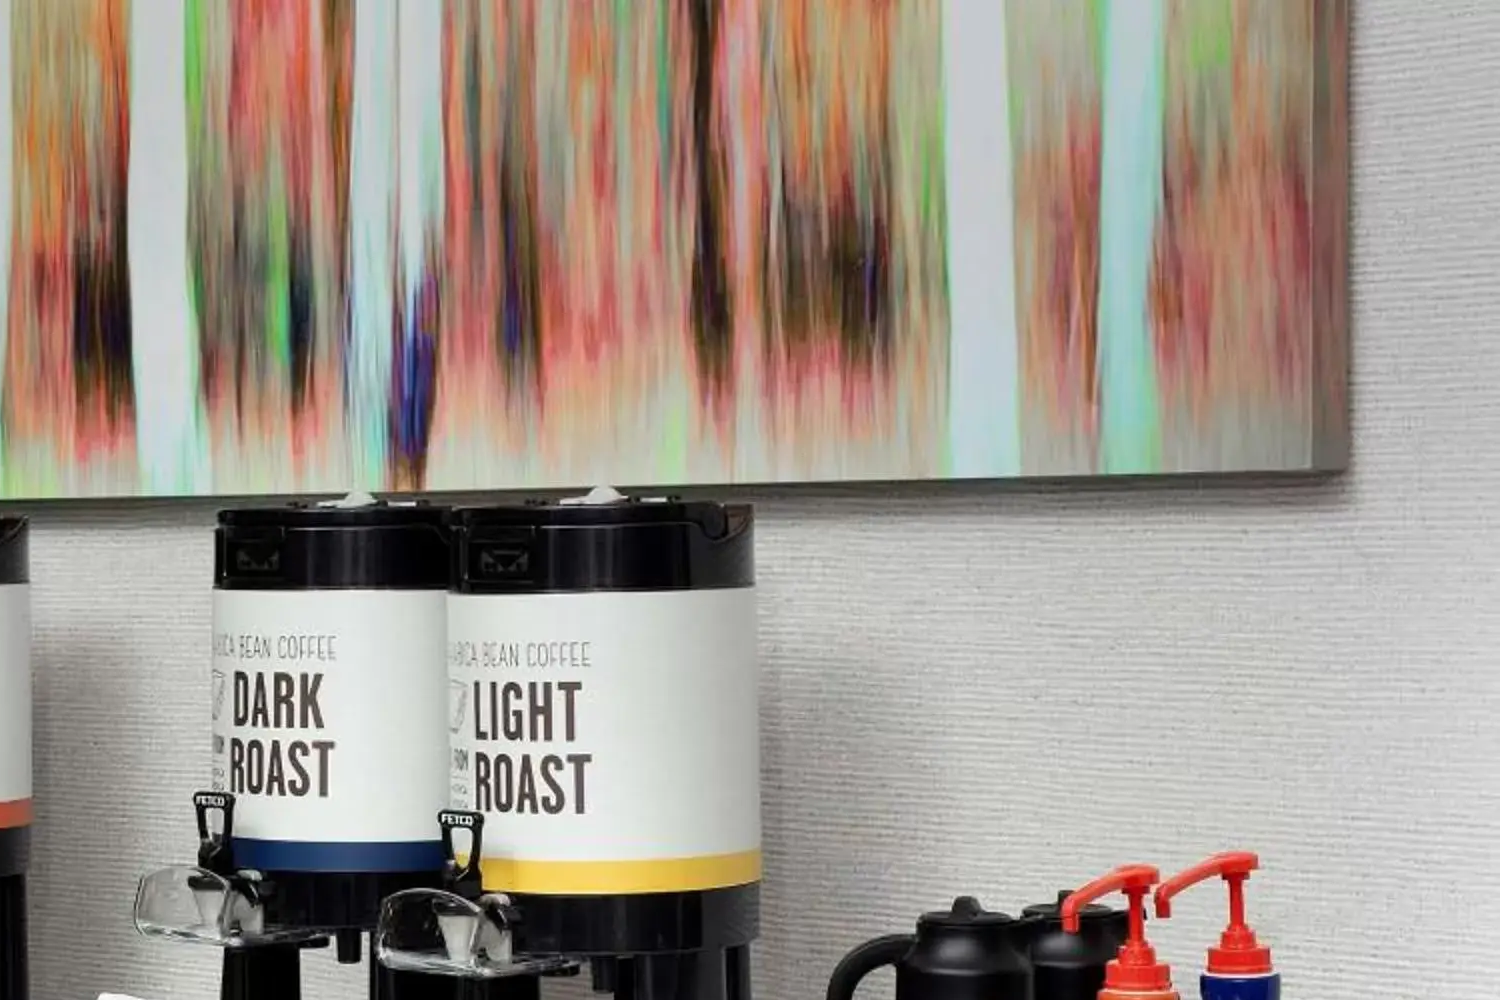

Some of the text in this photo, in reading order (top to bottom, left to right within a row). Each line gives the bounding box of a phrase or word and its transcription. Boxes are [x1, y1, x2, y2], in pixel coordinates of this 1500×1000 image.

[239, 635, 271, 660] BEAN
[277, 634, 338, 661] COFFEE
[482, 641, 519, 667] BEAN
[526, 641, 592, 667] COFFEE
[233, 670, 325, 729] DARK
[473, 680, 583, 742] LIGHT
[230, 737, 336, 798] ROAST
[474, 751, 593, 815] ROAST
[441, 813, 473, 826] FETCO
